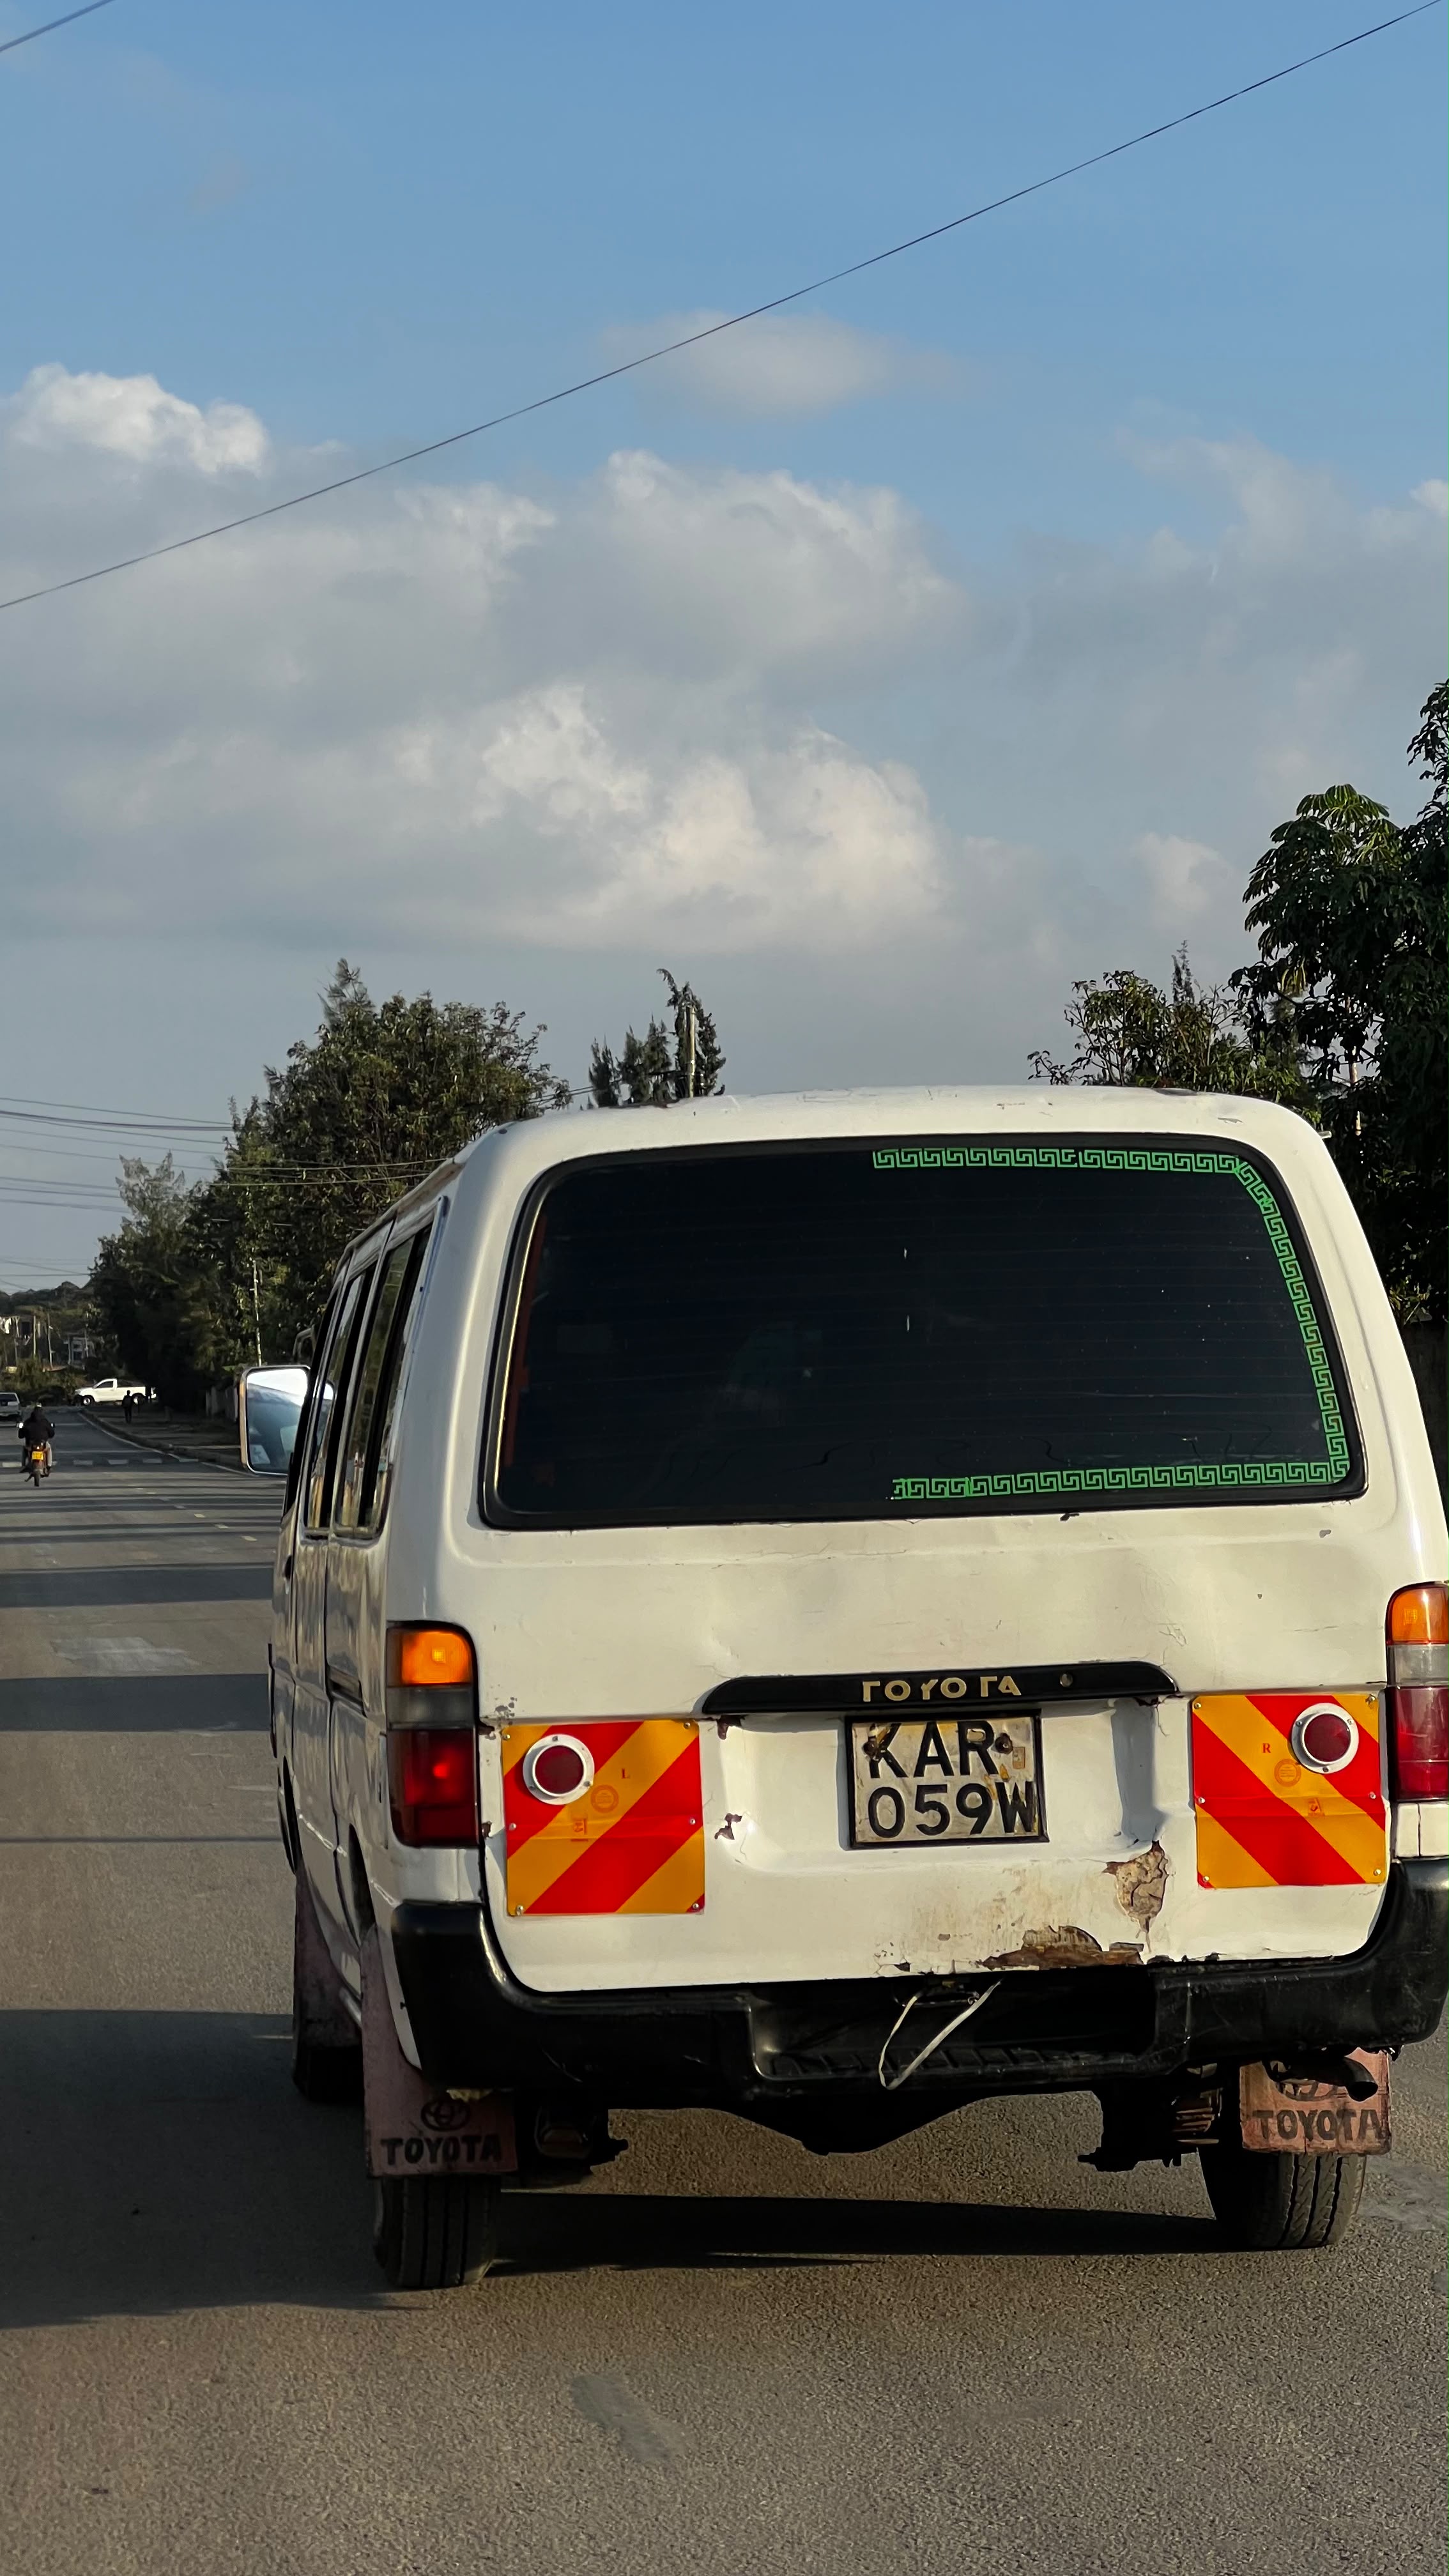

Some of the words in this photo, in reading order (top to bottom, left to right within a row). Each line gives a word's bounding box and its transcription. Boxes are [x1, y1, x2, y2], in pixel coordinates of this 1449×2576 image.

[865, 1720, 999, 1779] KAR
[1262, 1742, 1271, 1753] R
[622, 1768, 631, 1779] L
[868, 1781, 1034, 1839] 059W
[1252, 2109, 1383, 2141] TOYOTA
[381, 2134, 502, 2166] TOYOTA
